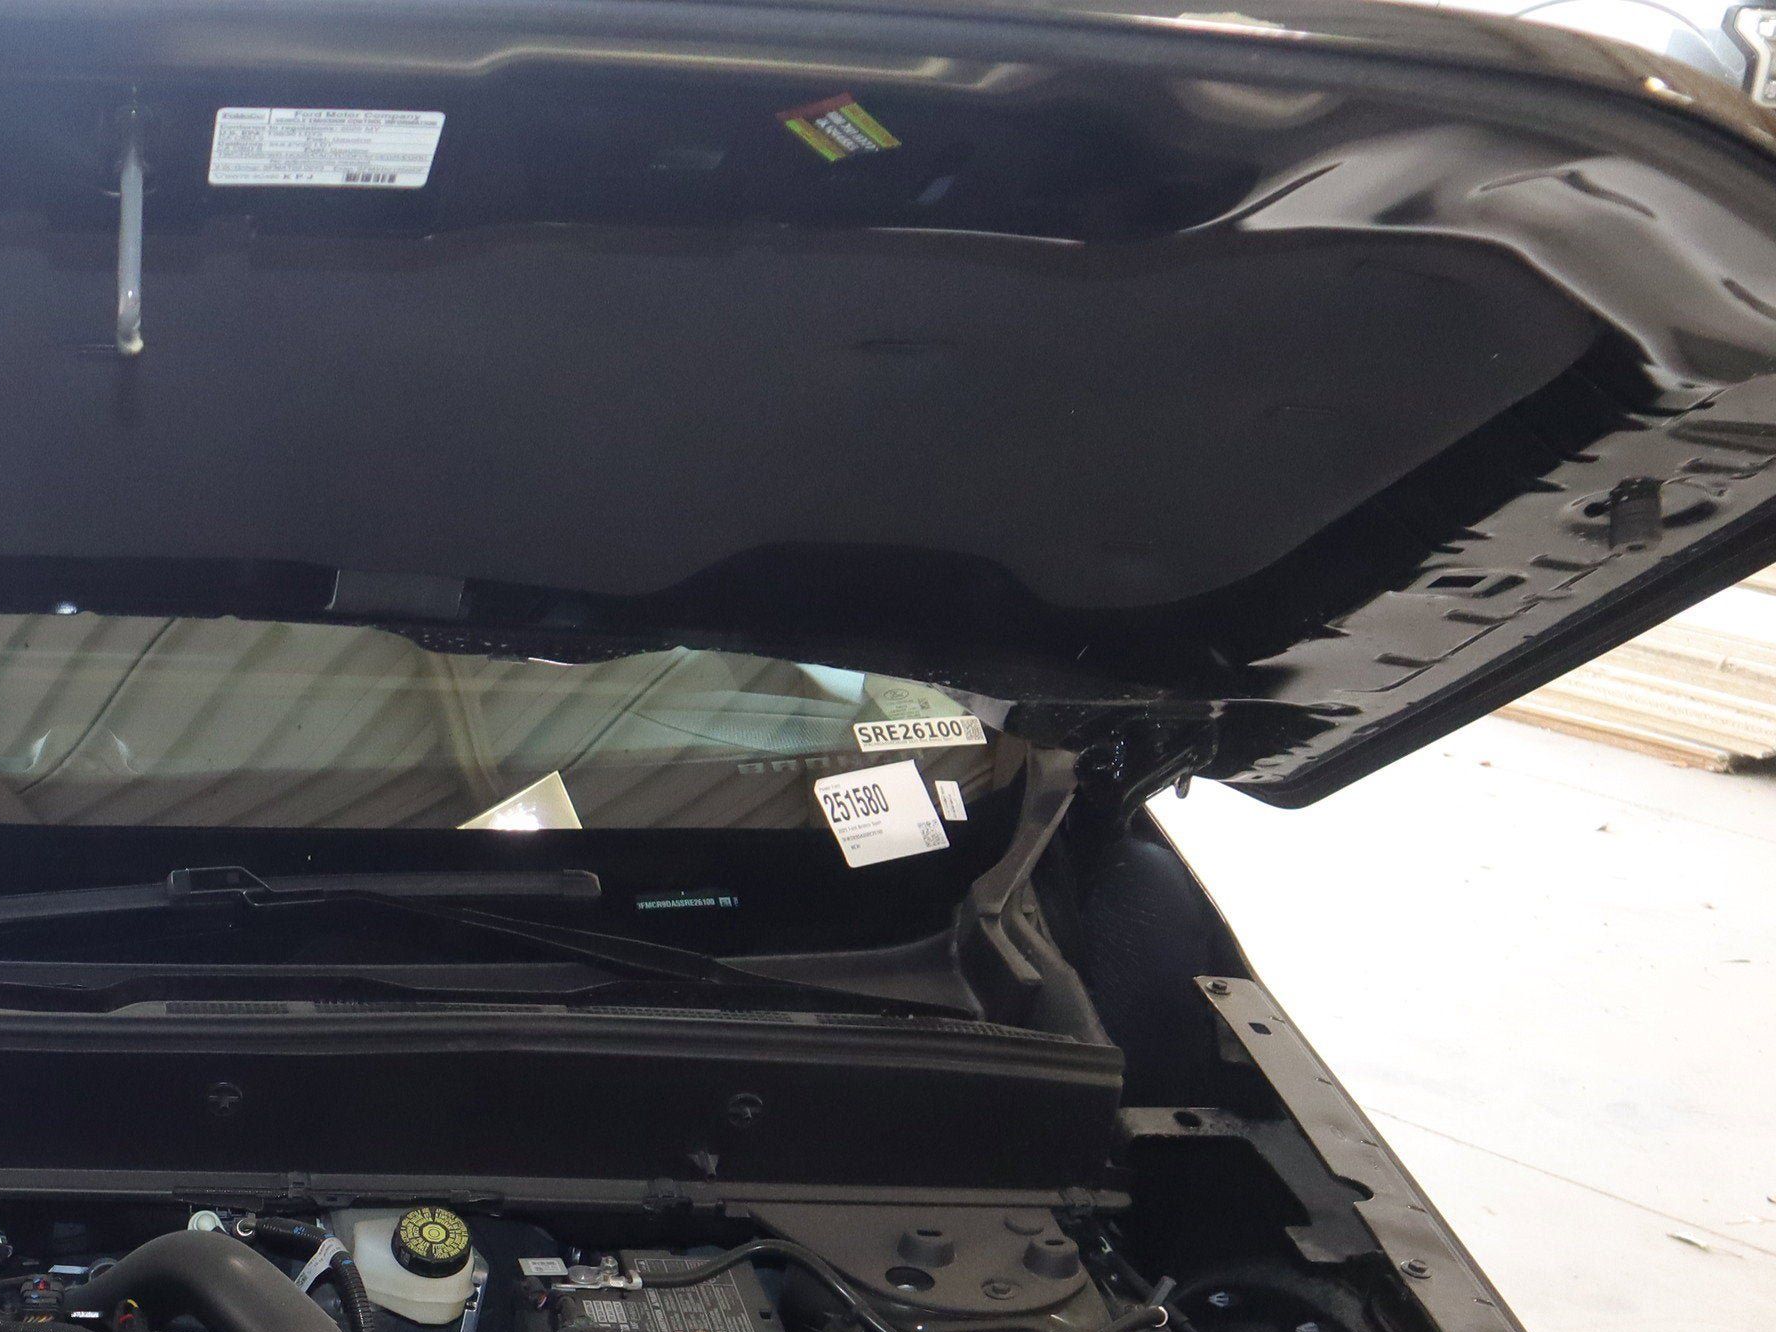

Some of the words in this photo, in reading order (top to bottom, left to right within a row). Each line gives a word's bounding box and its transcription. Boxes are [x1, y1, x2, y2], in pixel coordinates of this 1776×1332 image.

[293, 110, 323, 119] Ford
[325, 110, 360, 119] Motor
[363, 111, 422, 121] Company
[858, 720, 963, 743] SRE26100
[823, 783, 890, 823] 251580
